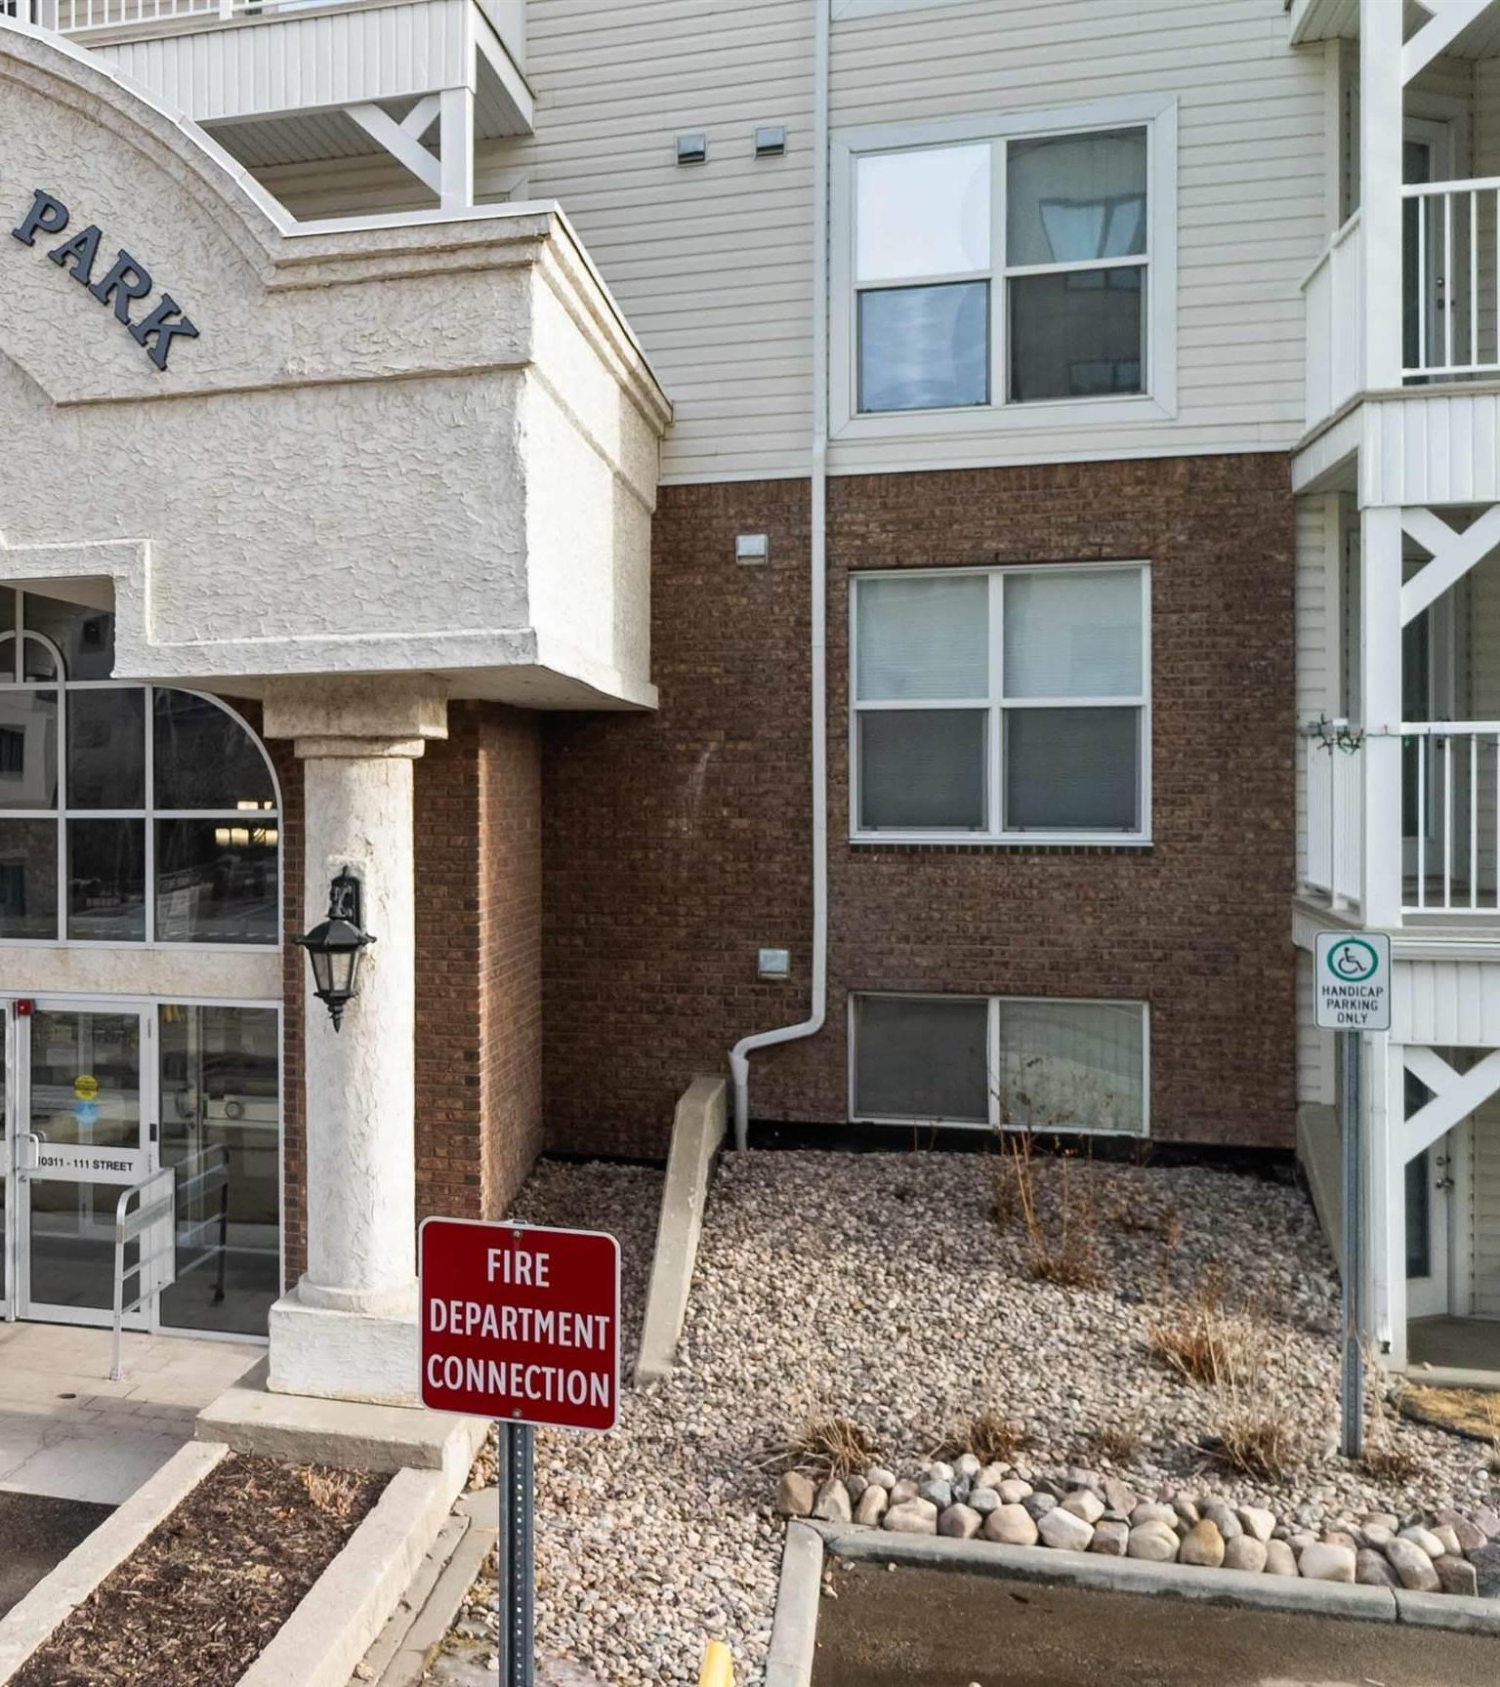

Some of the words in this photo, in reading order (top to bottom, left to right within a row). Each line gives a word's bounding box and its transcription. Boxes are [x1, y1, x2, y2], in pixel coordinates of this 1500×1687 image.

[11, 189, 201, 373] PARK
[1322, 985, 1384, 998] HANDICAP
[1327, 999, 1379, 1011] PARKING
[1337, 1012, 1368, 1024] ONLY
[74, 1159, 89, 1169] 111
[92, 1160, 134, 1171] STREET
[487, 1248, 550, 1288] FIRE
[430, 1298, 610, 1351] DEPARTMENT
[427, 1353, 609, 1408] CONNECTION
